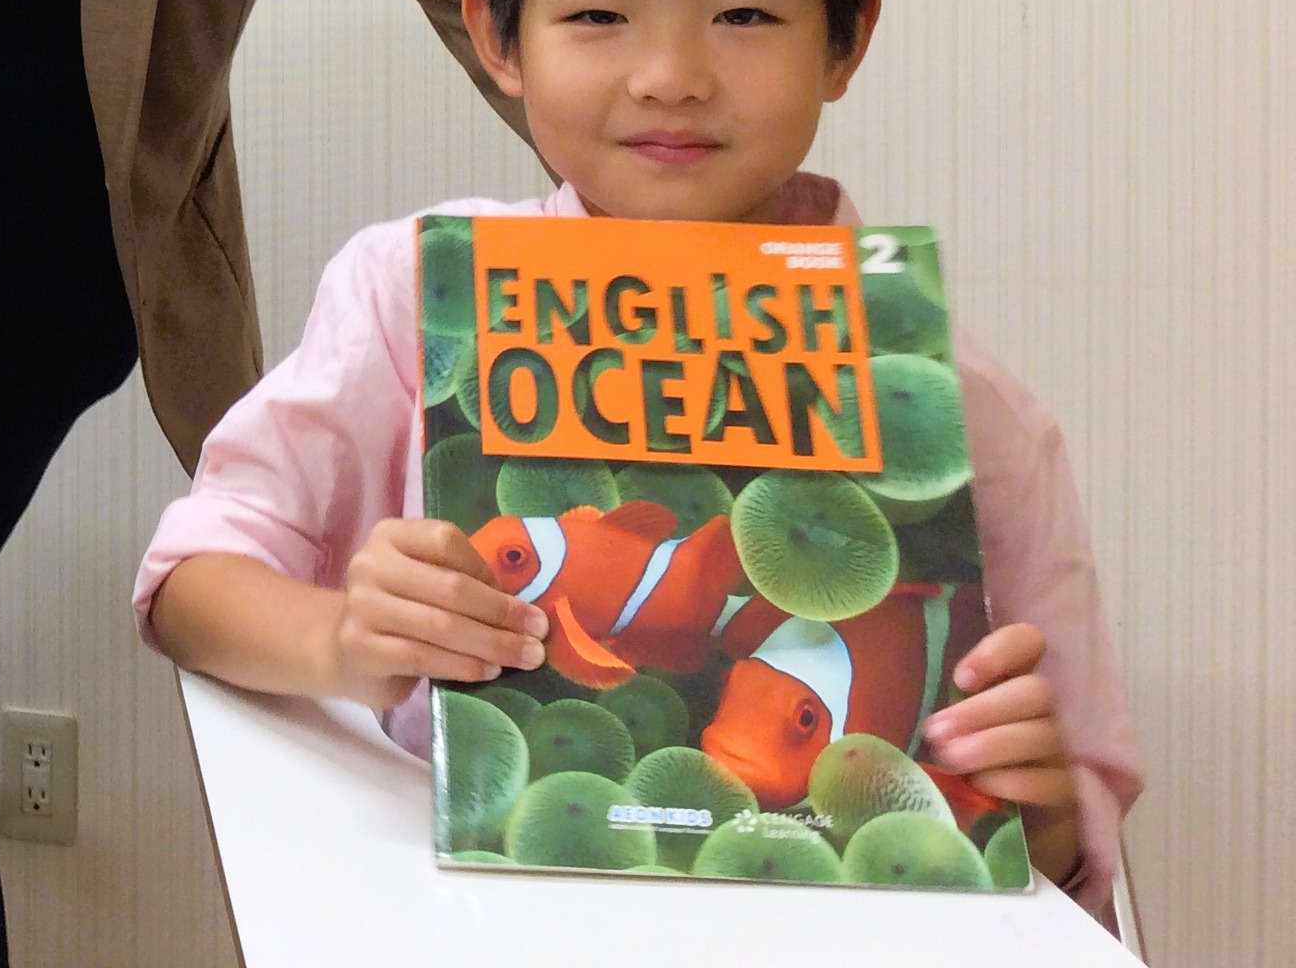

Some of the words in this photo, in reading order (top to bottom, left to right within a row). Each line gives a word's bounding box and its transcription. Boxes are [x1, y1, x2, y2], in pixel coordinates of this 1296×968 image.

[858, 233, 905, 274] 2
[486, 267, 852, 355] ENGLISH
[488, 346, 866, 459] OCEAN
